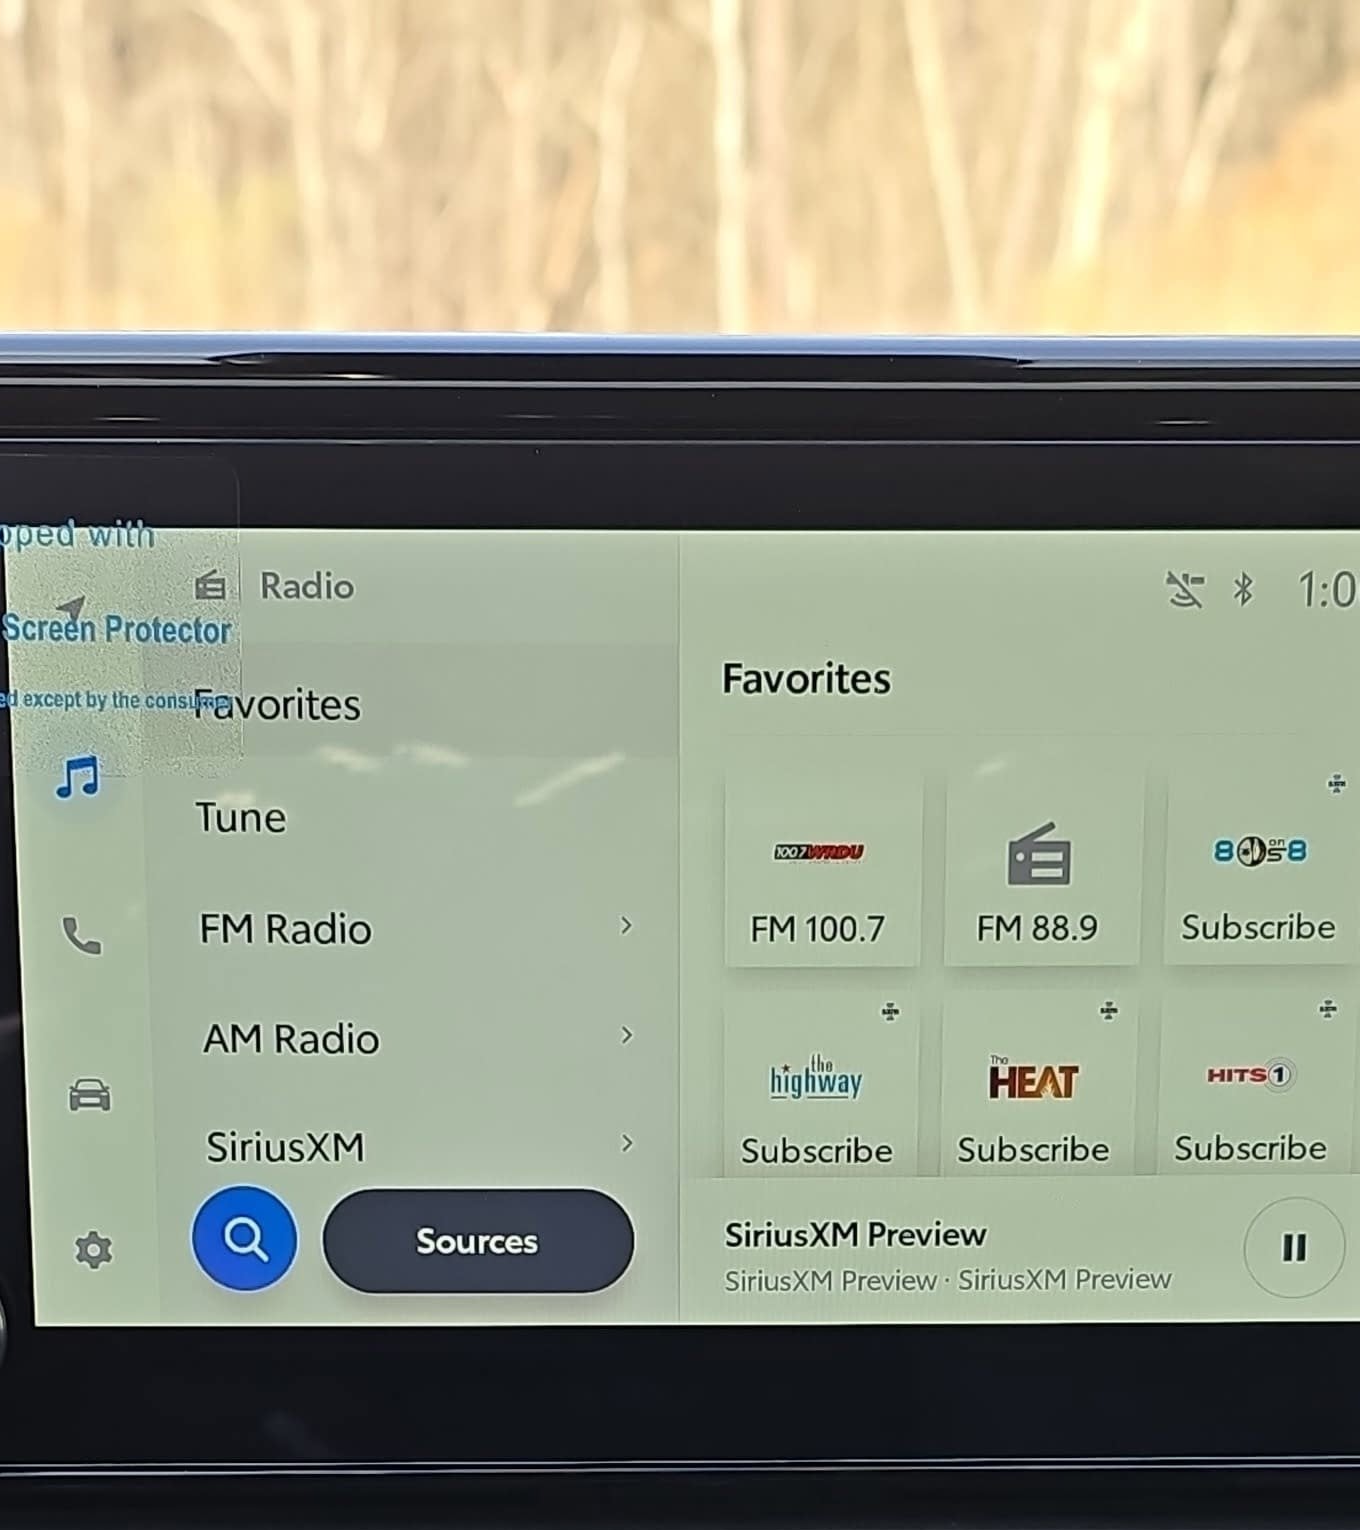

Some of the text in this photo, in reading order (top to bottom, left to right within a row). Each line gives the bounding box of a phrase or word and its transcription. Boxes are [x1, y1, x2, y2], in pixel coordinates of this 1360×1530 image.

[88, 518, 155, 549] with
[261, 571, 354, 600] Radio
[2, 613, 96, 643] Screen
[105, 614, 232, 644] Protector
[723, 662, 892, 696] Favorites
[23, 690, 82, 711] except
[85, 690, 108, 712] by
[112, 690, 140, 710] the
[194, 686, 361, 720] Favorites
[195, 801, 287, 833] Tune
[200, 912, 373, 947] FM Radio
[751, 915, 886, 943] FM 100.7
[977, 915, 1099, 943] FM 88.9
[1182, 913, 1337, 943] Subscribe
[203, 1022, 380, 1056] AM Radio
[771, 1067, 862, 1099] highway
[990, 1065, 1079, 1098] HEAT
[207, 1131, 366, 1165] SiriusXM
[741, 1137, 894, 1165] Subscribe
[957, 1136, 1111, 1164] Subscribe
[1175, 1134, 1328, 1163] Subscribe
[416, 1227, 539, 1256] Sources
[725, 1220, 987, 1248] SiriusXM Preview
[725, 1268, 1172, 1293] SiriusXM Preview SiriusXM Preview
